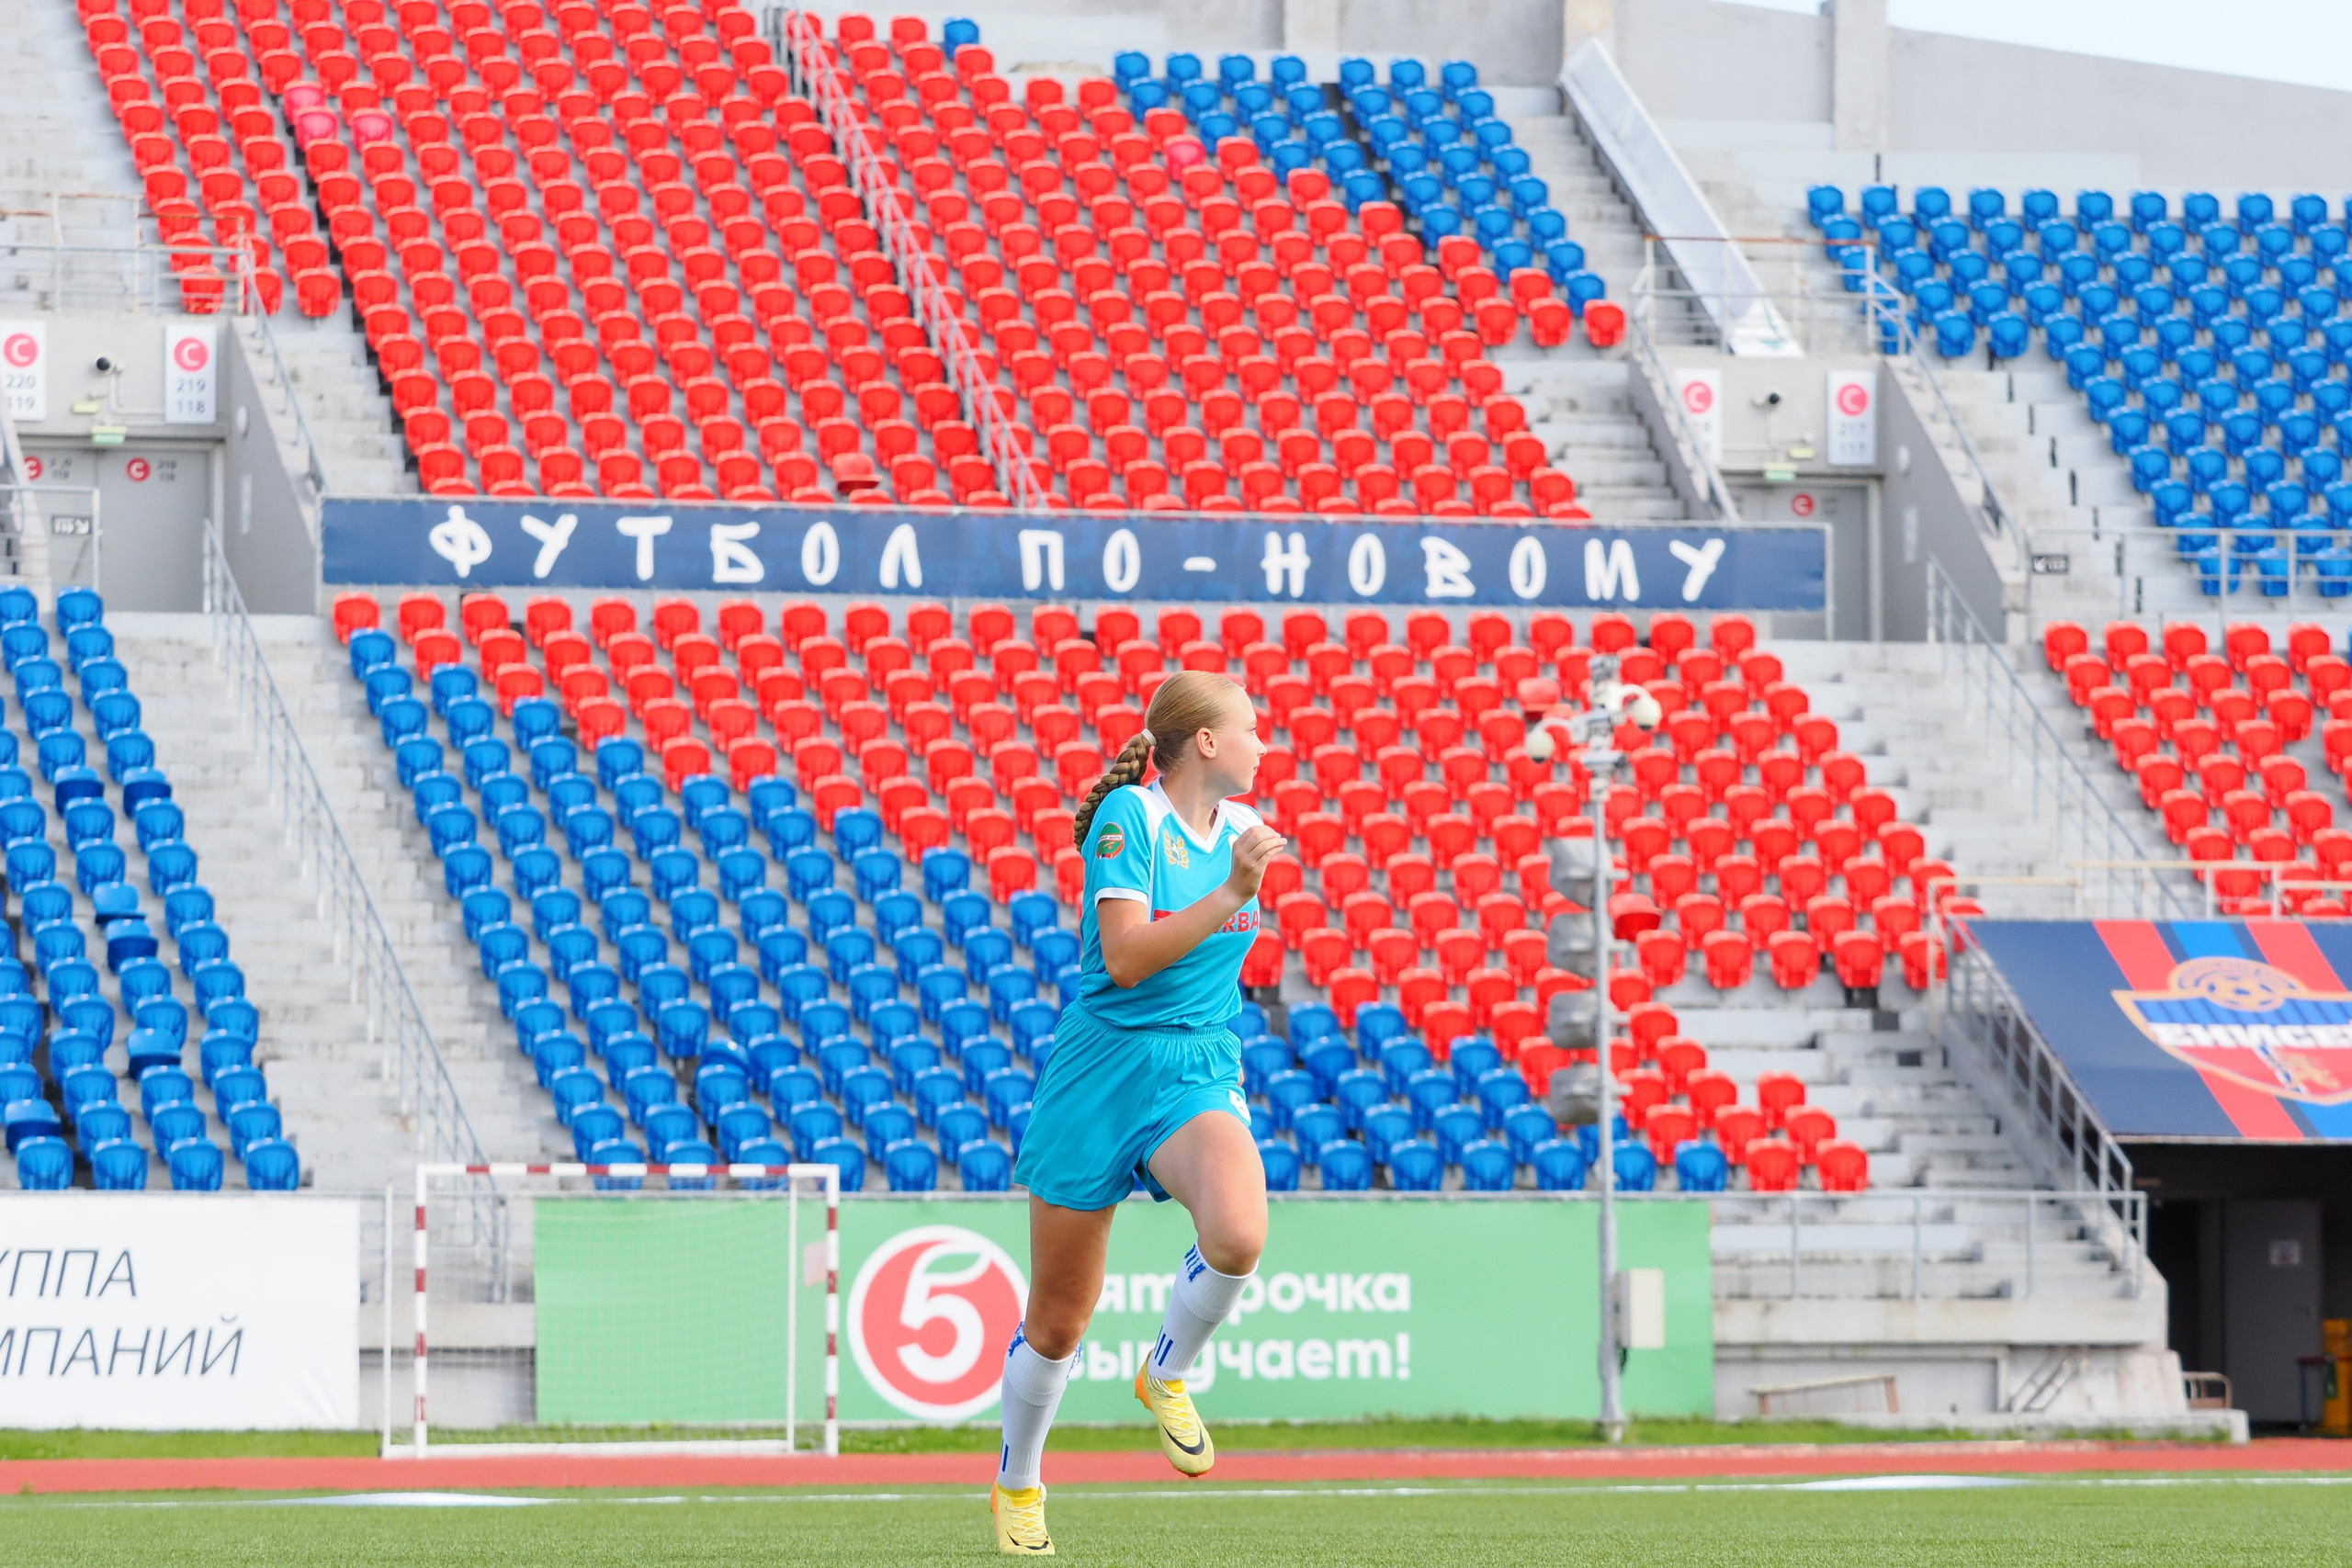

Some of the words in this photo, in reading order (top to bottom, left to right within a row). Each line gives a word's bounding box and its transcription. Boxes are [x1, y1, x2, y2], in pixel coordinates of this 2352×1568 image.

[6, 374, 36, 389] 220
[176, 378, 206, 393] 219
[6, 396, 36, 410] 119
[429, 504, 922, 590] ФУТБОЛ
[1018, 528, 1725, 603] ПО-НОВОМУ
[1213, 910, 1259, 933] RBA
